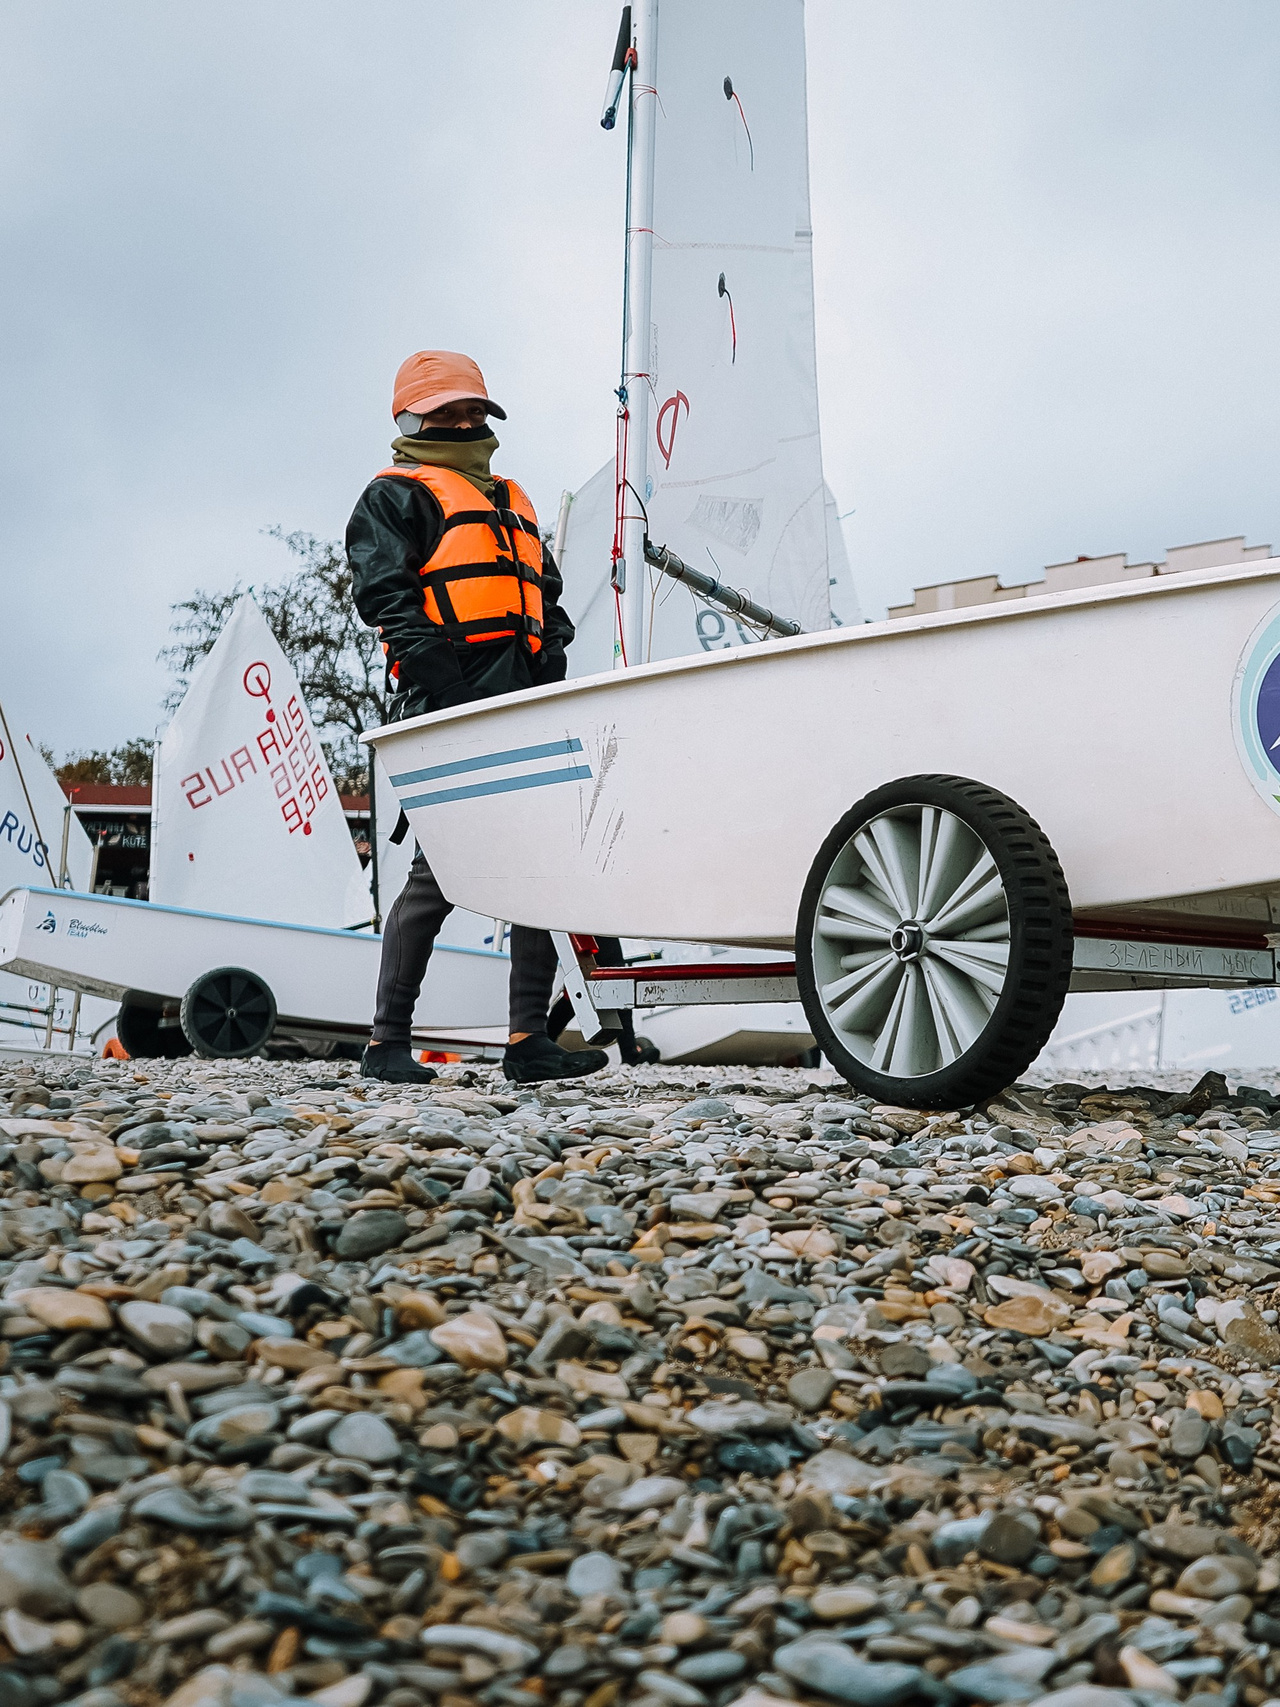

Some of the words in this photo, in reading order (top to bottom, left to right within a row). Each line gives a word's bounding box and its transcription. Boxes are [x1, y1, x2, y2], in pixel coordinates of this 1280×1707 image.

[256, 694, 304, 765] RUS
[281, 764, 328, 834] 936
[0, 811, 49, 867] RUS
